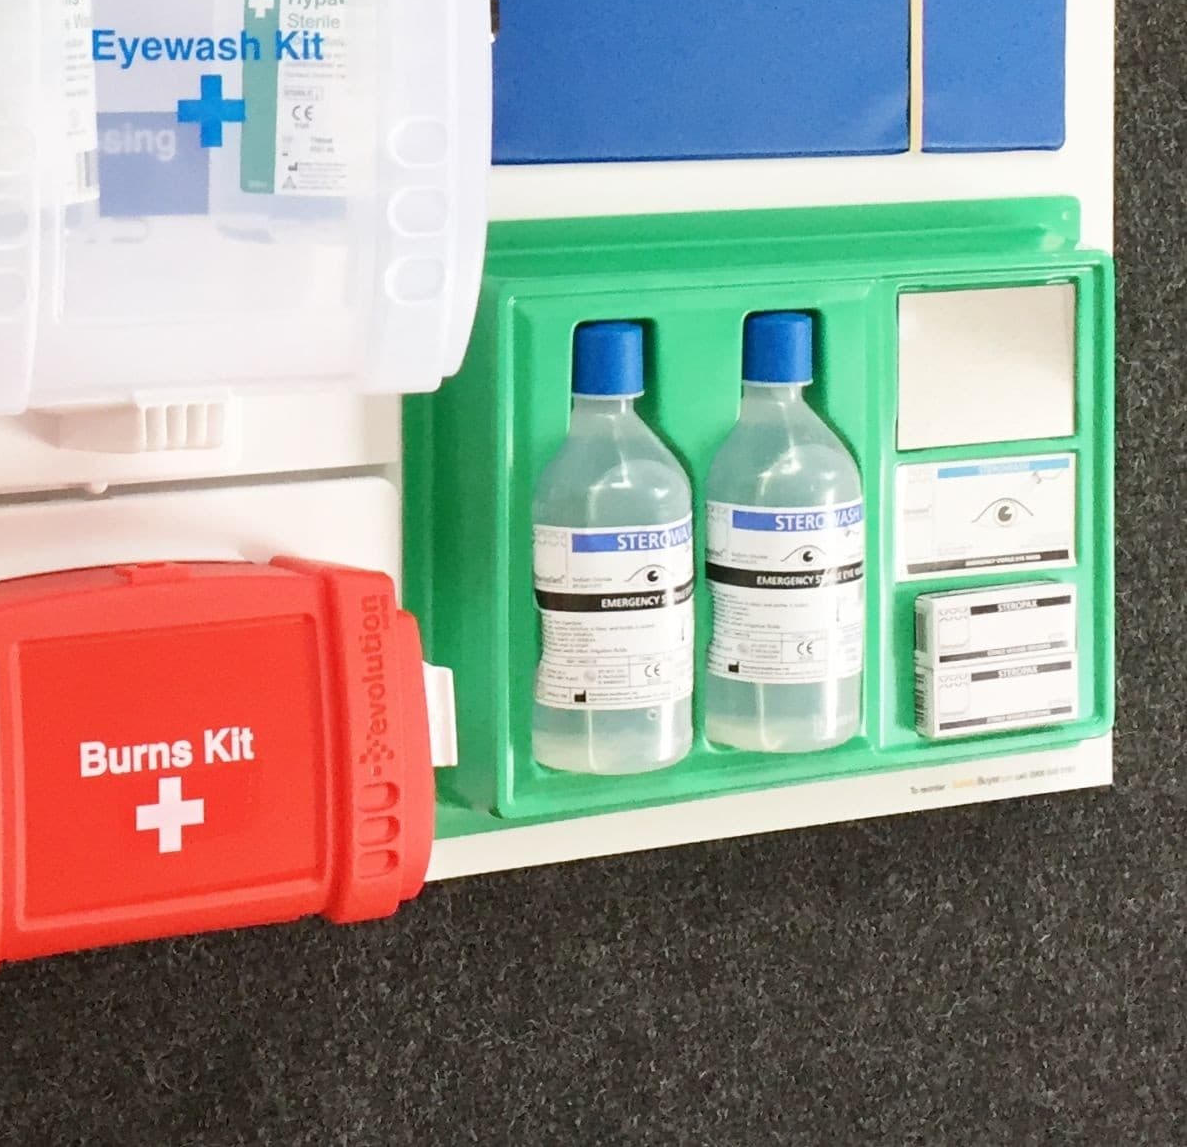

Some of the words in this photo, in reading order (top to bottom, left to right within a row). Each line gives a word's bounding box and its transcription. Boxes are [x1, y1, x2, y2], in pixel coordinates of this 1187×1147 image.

[91, 29, 260, 69] Eyewash
[275, 29, 325, 61] Kit
[101, 120, 177, 162] sing
[756, 575, 813, 586] EMERGENCY
[600, 595, 661, 608] EMERGENCY
[358, 594, 388, 736] evolution
[79, 738, 193, 778] Burns
[203, 726, 255, 764] Kit
